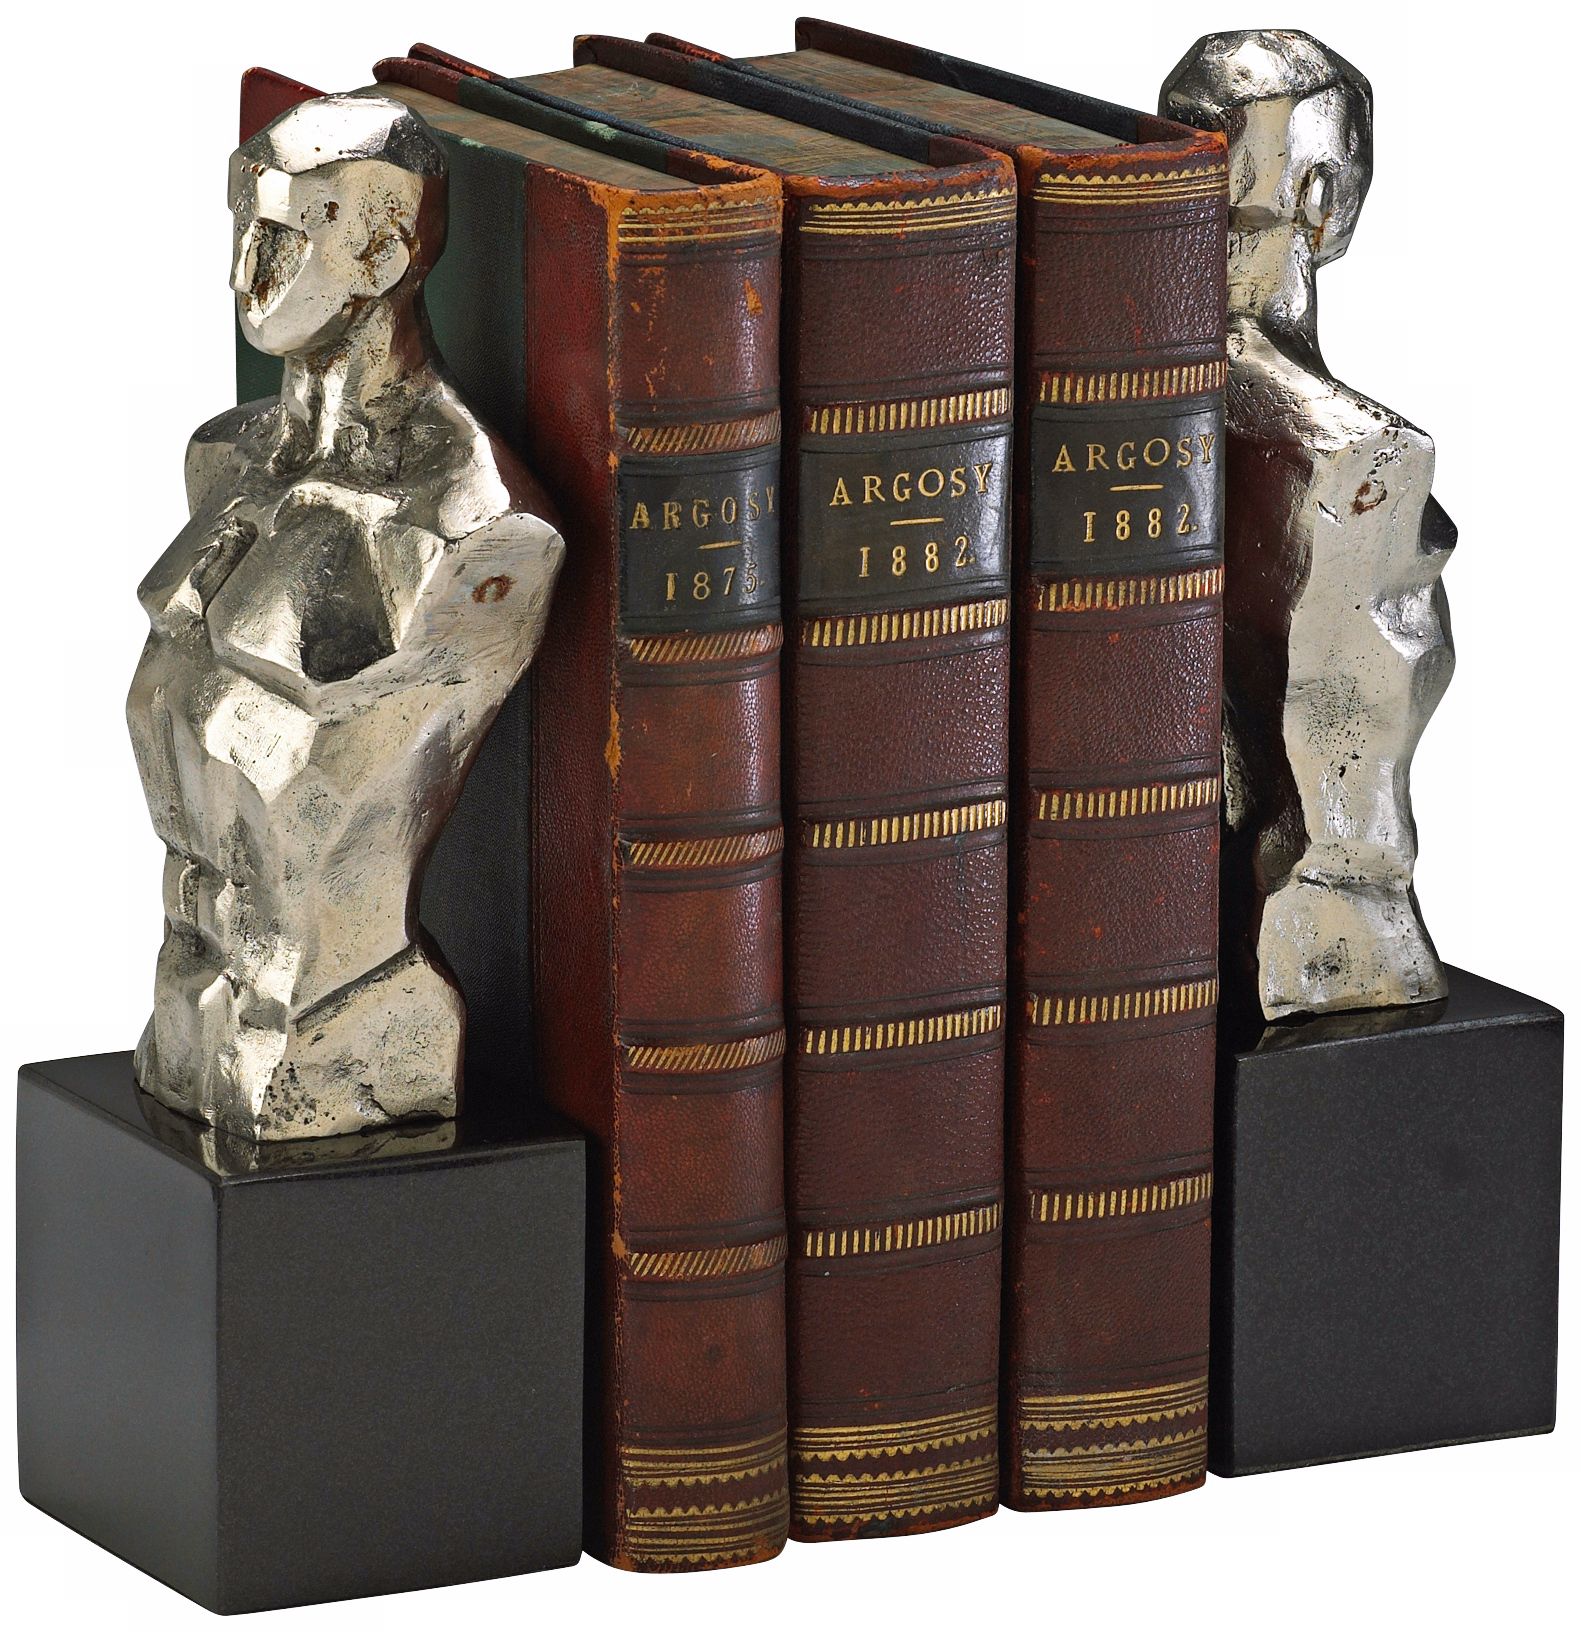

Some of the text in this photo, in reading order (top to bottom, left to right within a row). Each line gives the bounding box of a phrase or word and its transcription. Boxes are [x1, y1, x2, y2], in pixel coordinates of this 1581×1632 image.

[1051, 433, 1216, 473] ARGOSY
[829, 462, 993, 506] ARGOSY
[629, 485, 776, 530] ARGOSY
[1083, 503, 1199, 543] 1882.
[858, 535, 976, 578] 1882.
